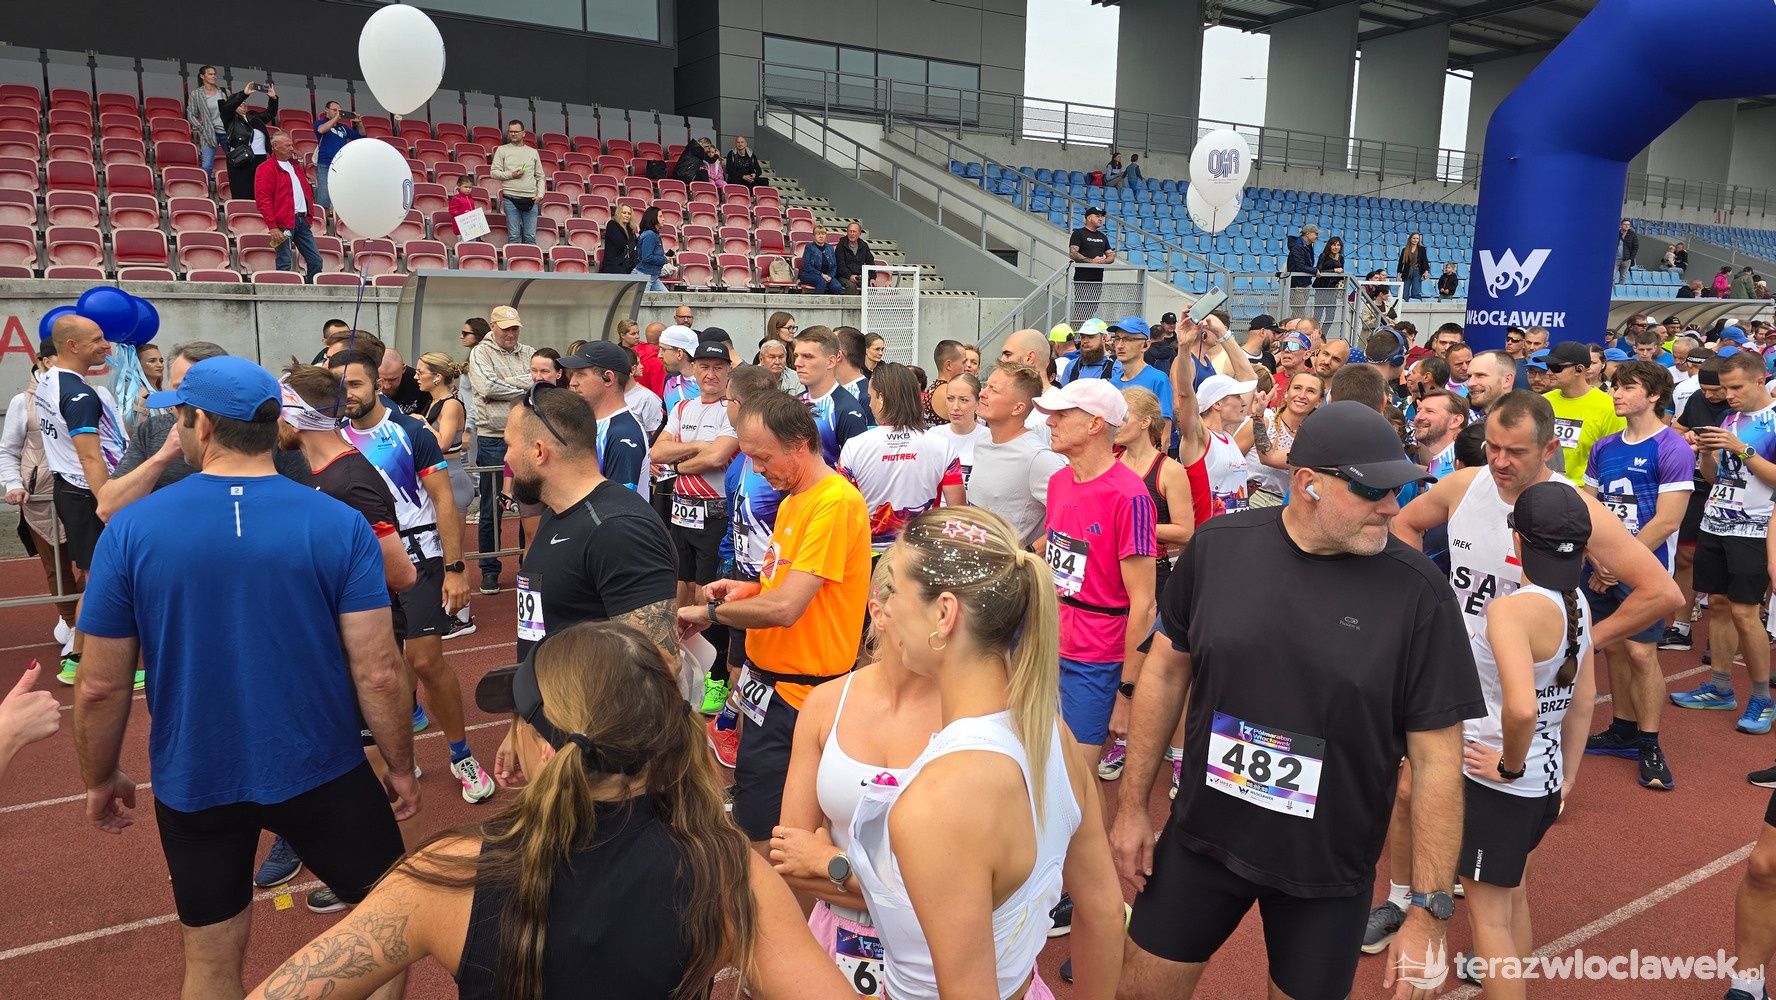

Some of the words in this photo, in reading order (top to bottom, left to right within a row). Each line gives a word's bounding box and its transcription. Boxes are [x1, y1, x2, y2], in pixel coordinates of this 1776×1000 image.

[1466, 310, 1566, 328] WŁOCŁAWEK
[886, 432, 911, 441] WKB
[881, 453, 918, 462] PIOTREK
[1713, 485, 1736, 501] 241
[674, 503, 698, 520] 204
[1602, 503, 1628, 519] 73
[1452, 538, 1473, 551] IREK
[1047, 544, 1076, 575] 584
[518, 592, 535, 621] 89
[1221, 742, 1303, 792] 482
[854, 960, 885, 996] 6
